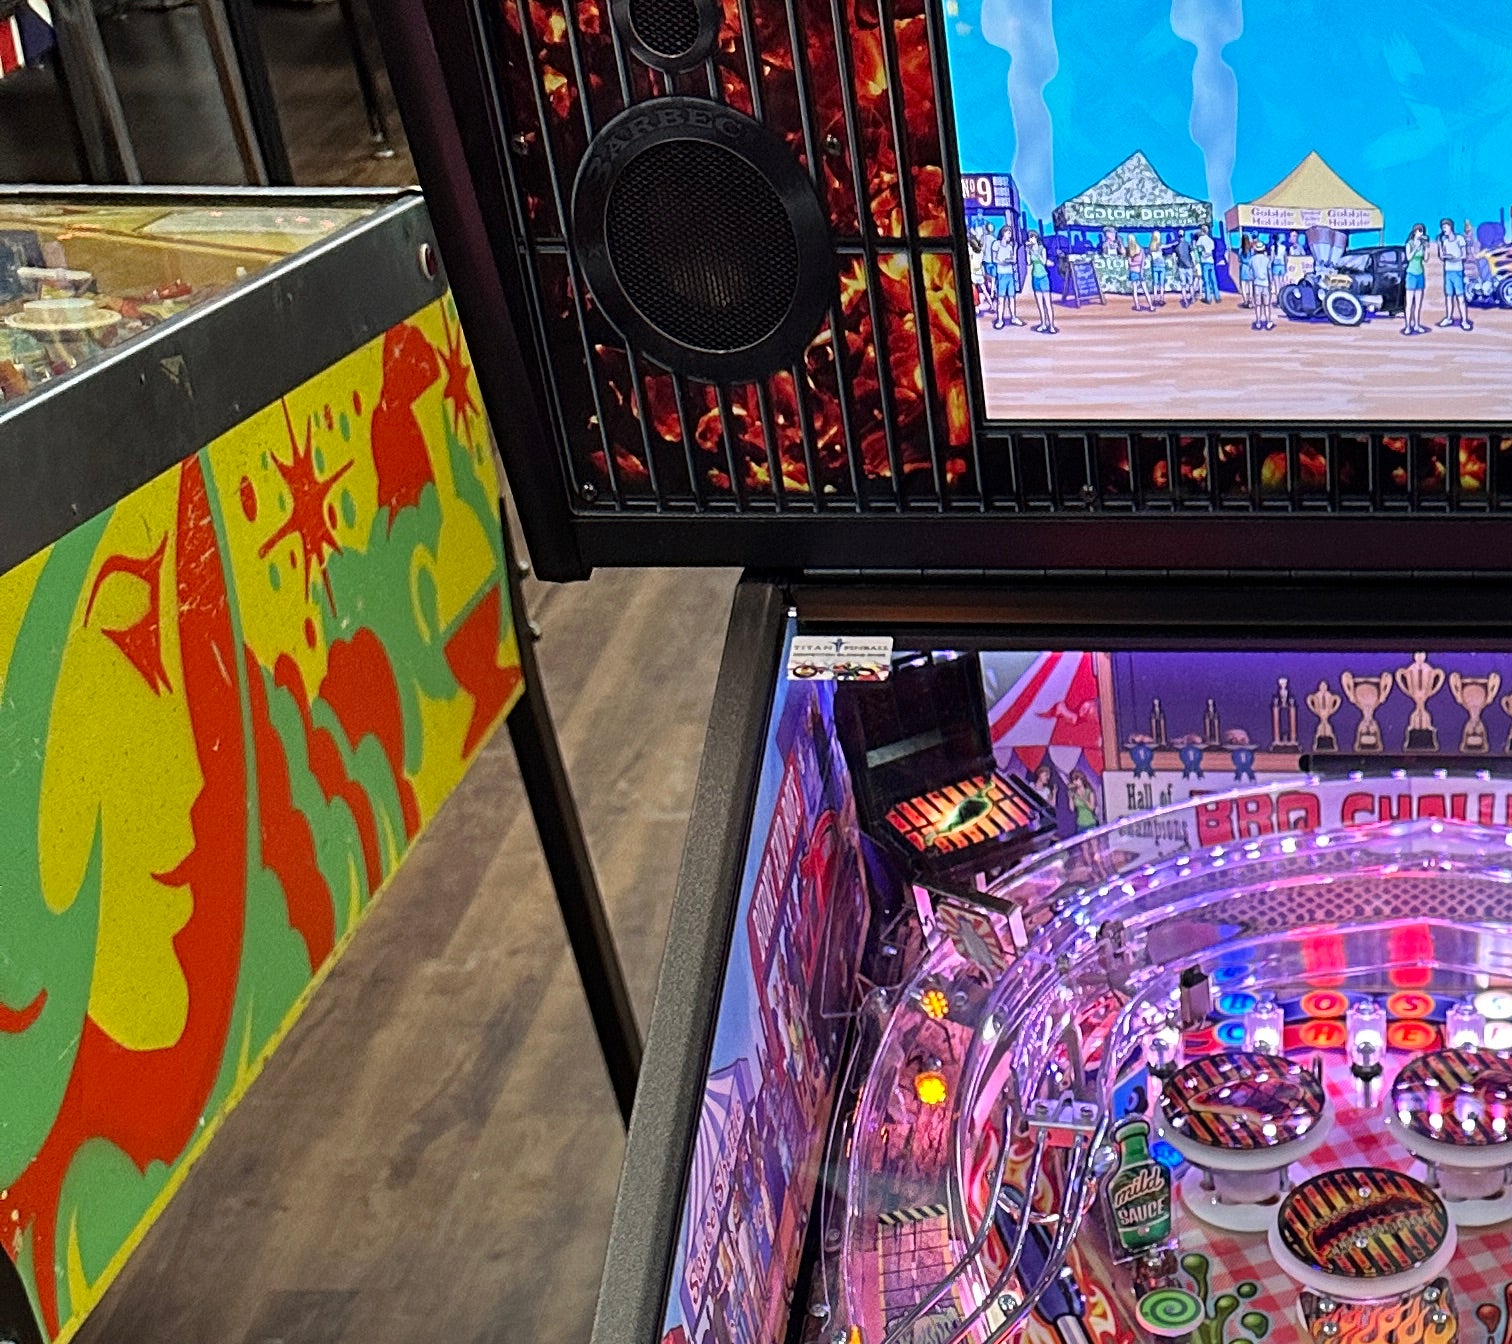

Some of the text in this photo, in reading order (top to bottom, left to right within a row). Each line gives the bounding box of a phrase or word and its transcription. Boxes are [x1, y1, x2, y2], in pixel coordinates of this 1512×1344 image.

[1083, 206, 1135, 220] Gator
[1126, 782, 1174, 811] Hall of
[1191, 788, 1322, 848] BBQ
[1113, 1165, 1166, 1208] mild
[1117, 1197, 1168, 1227] SAUCE
